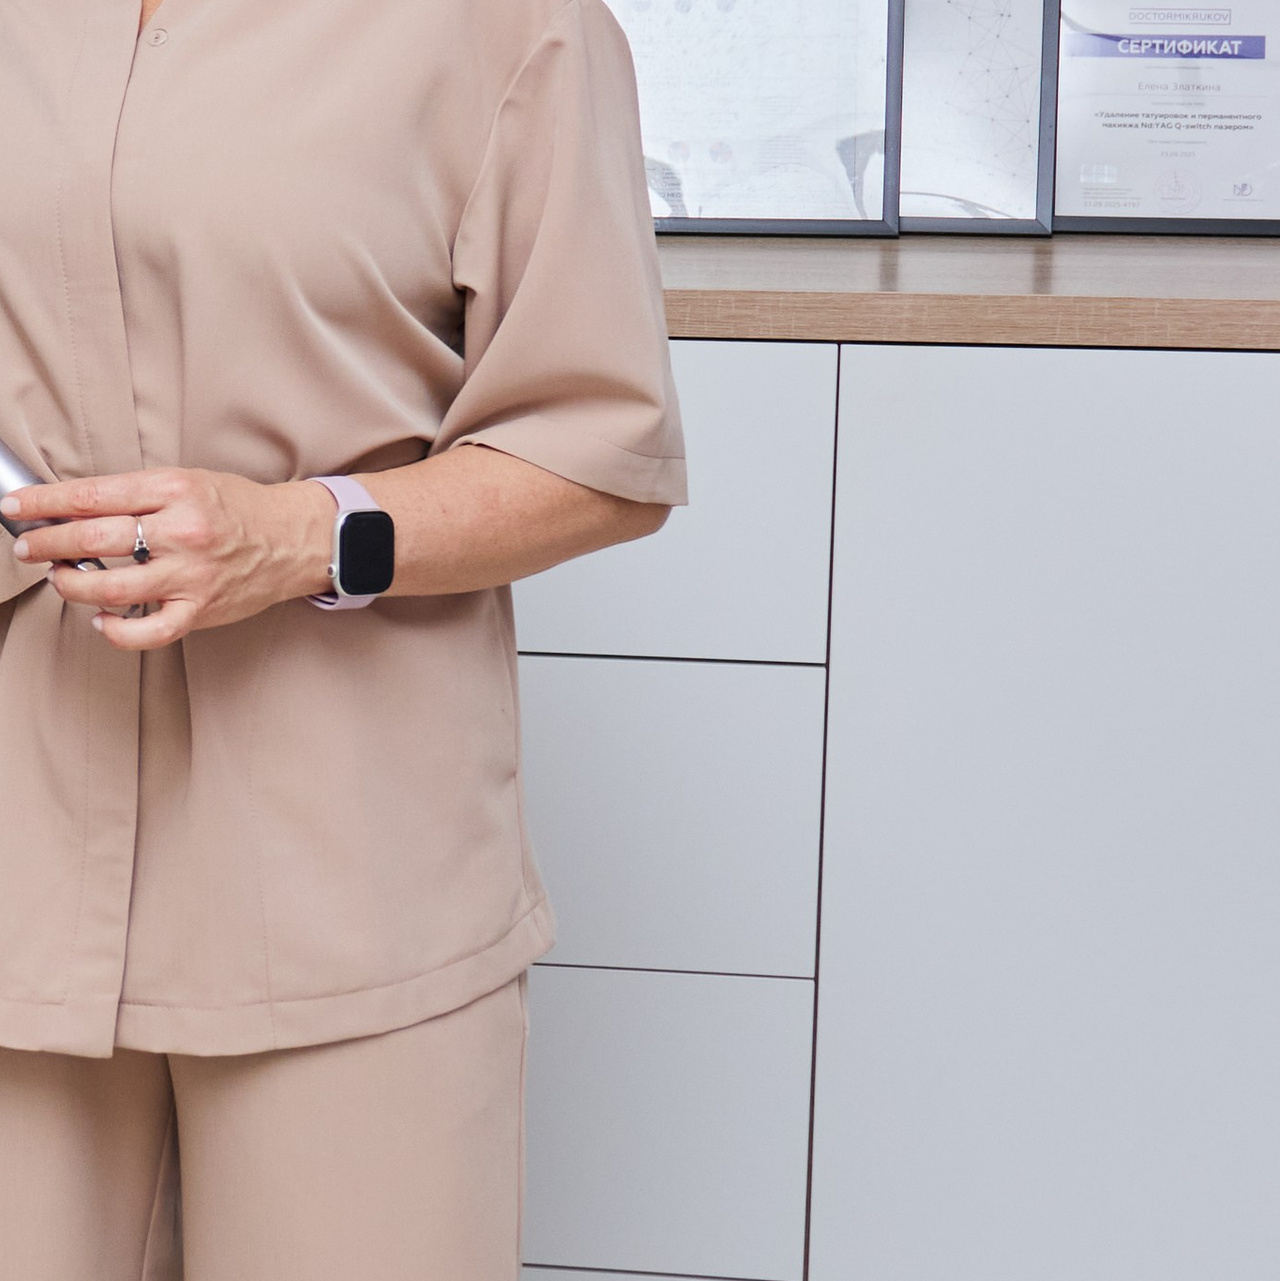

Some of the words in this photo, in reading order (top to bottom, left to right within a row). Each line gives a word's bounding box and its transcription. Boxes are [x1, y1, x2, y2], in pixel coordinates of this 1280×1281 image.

[1129, 11, 1229, 21] DOCTORMIKRUKOV
[1117, 39, 1243, 55] СЕРТИФИКАТ
[1138, 81, 1169, 91] Елена
[1172, 81, 1221, 91] Златкина
